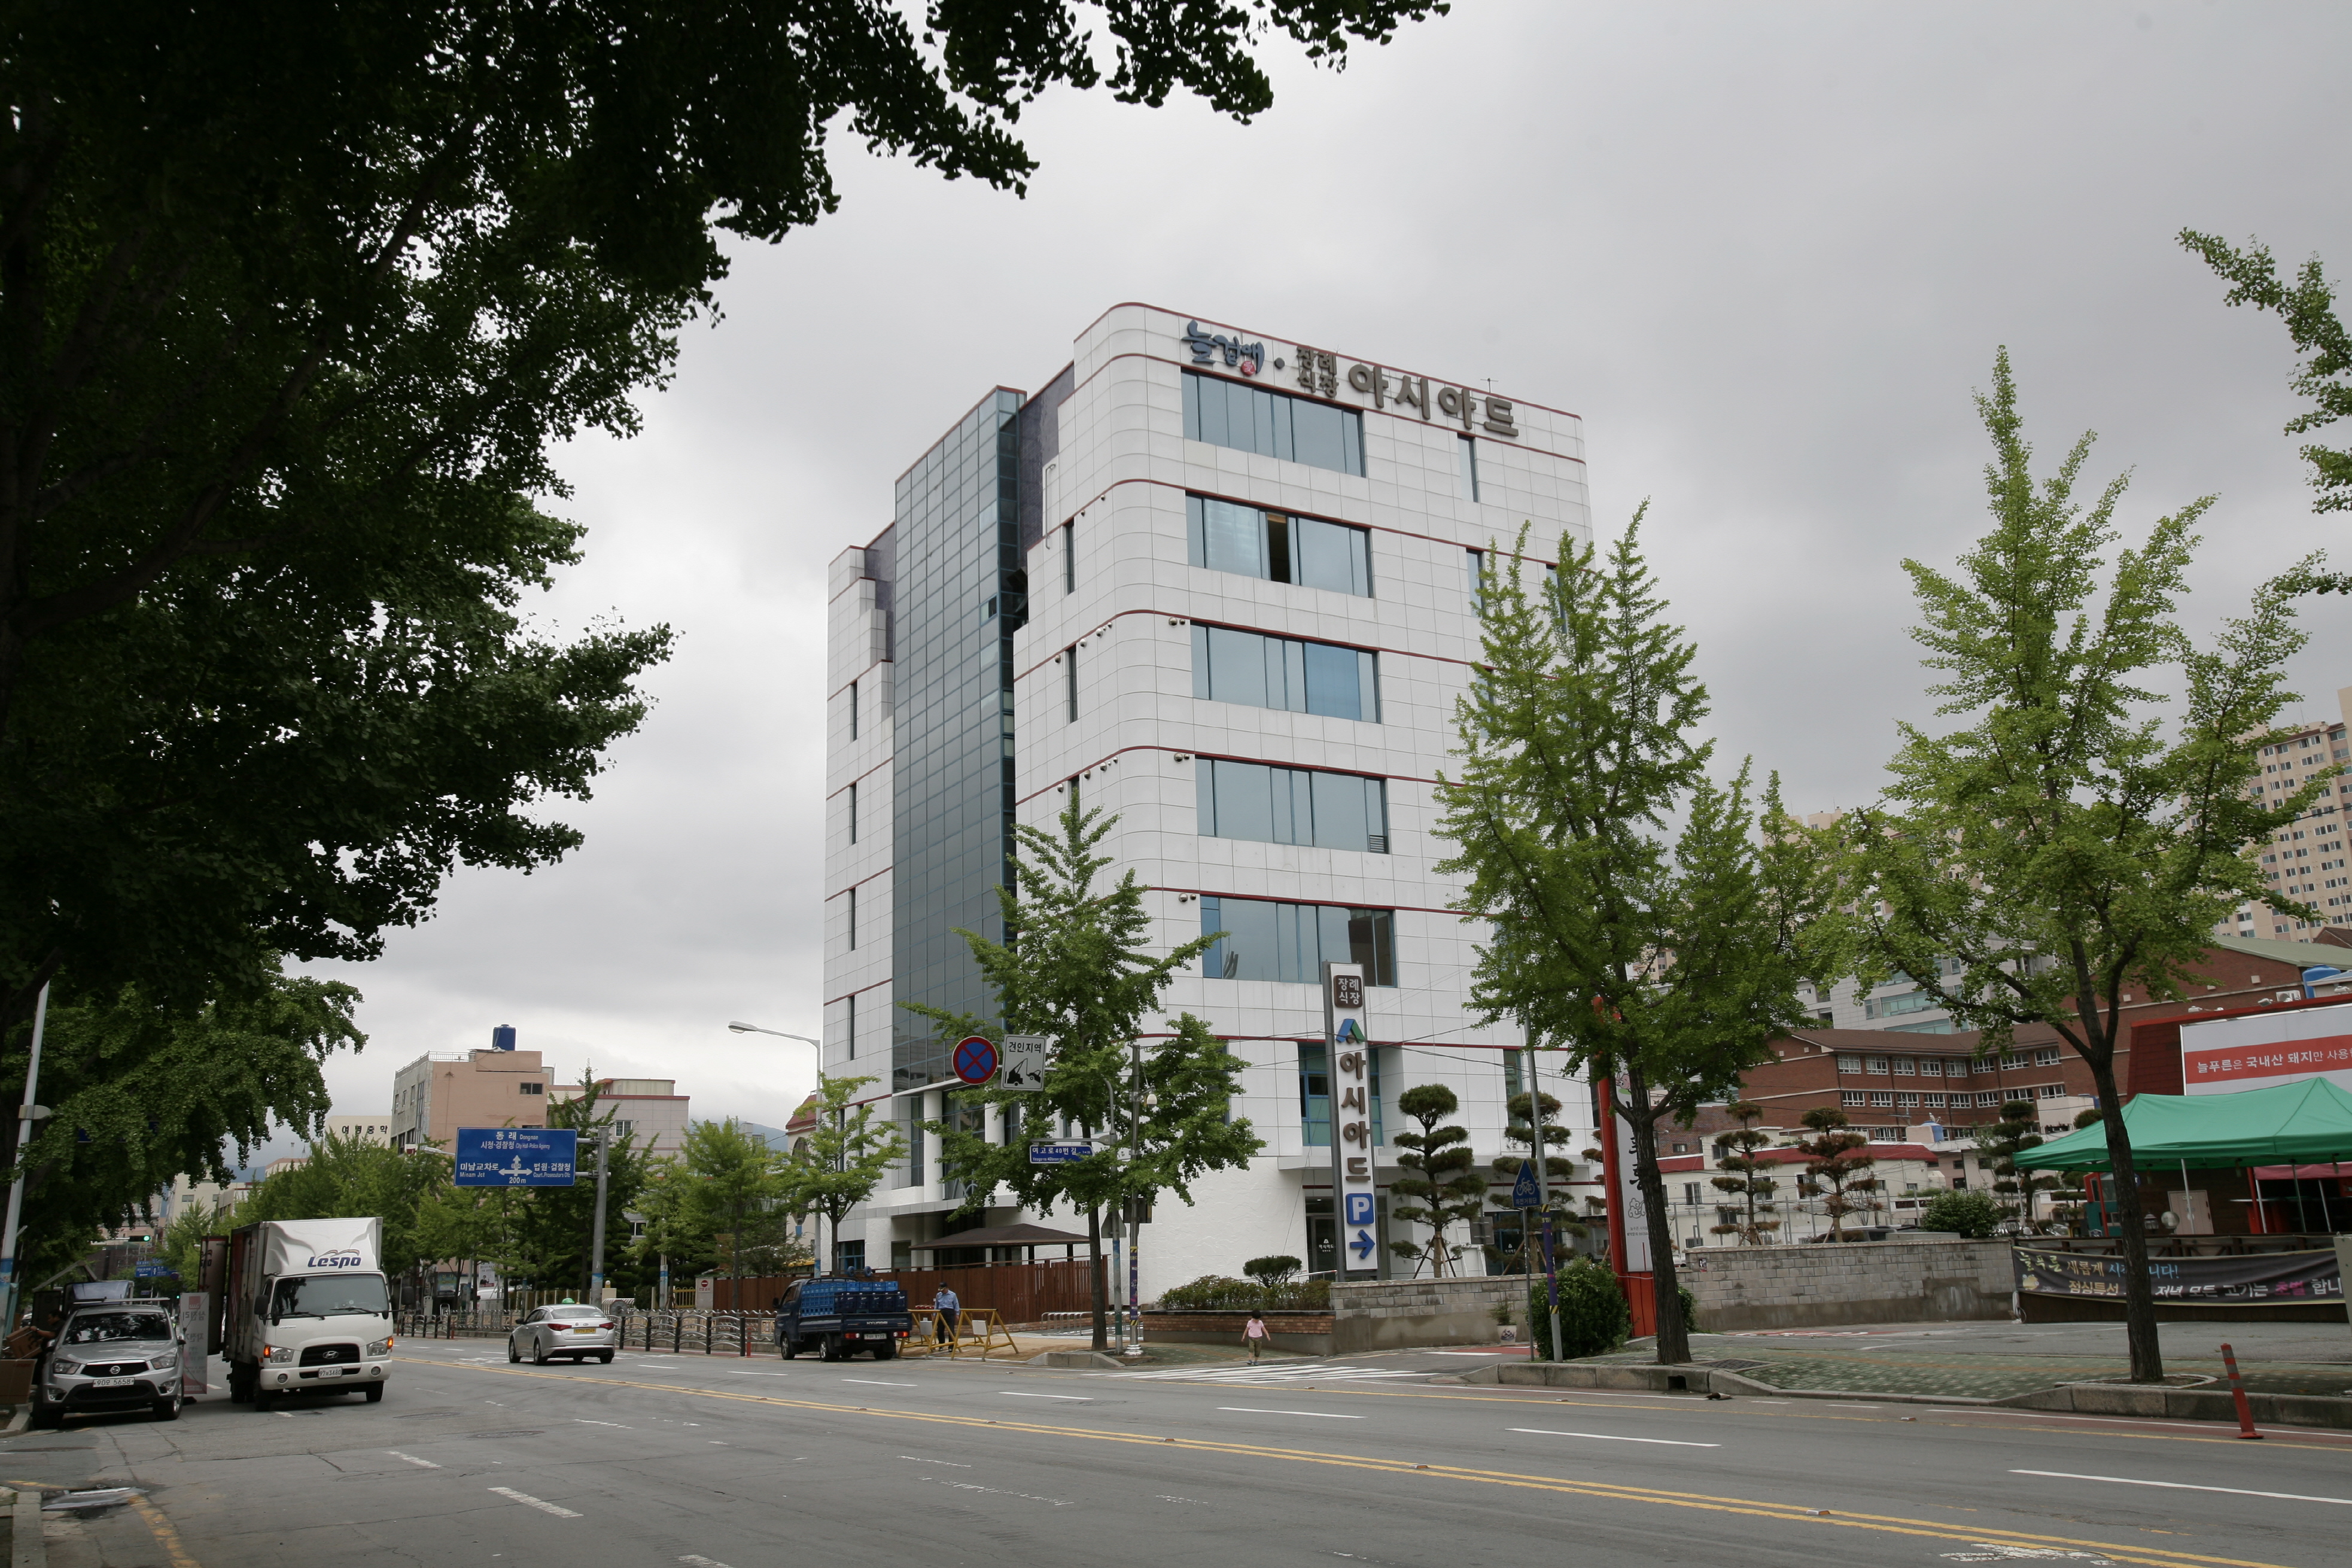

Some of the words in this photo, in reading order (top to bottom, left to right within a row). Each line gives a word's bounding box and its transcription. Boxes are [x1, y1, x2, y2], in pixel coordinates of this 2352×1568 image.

[1297, 345, 1337, 375] 장례
[1297, 369, 1339, 398] 식장
[1348, 364, 1519, 437] 아시아드
[1338, 978, 1359, 991] 장례
[1338, 991, 1361, 1005] 식장
[1009, 1042, 1042, 1054] 견인지역
[2197, 1059, 2243, 1073] 늘푸른은
[2246, 1054, 2283, 1068] 국내산
[2287, 1051, 2323, 1064] 돼지만
[1340, 1052, 1371, 1182] 아시아드
[495, 1131, 517, 1140] 동래
[460, 1162, 499, 1171] 미남교차로
[1352, 1196, 1370, 1221] P
[308, 1256, 362, 1269] Lespo
[2019, 1251, 2062, 1272] 늘푸른
[2067, 1260, 2104, 1277] 새롭게
[2069, 1280, 2119, 1296] 점심특선
[2155, 1285, 2183, 1298] 저녁
[2188, 1284, 2219, 1298] 모든
[2222, 1283, 2268, 1298] 고기는
[2311, 1277, 2343, 1295] 합니
